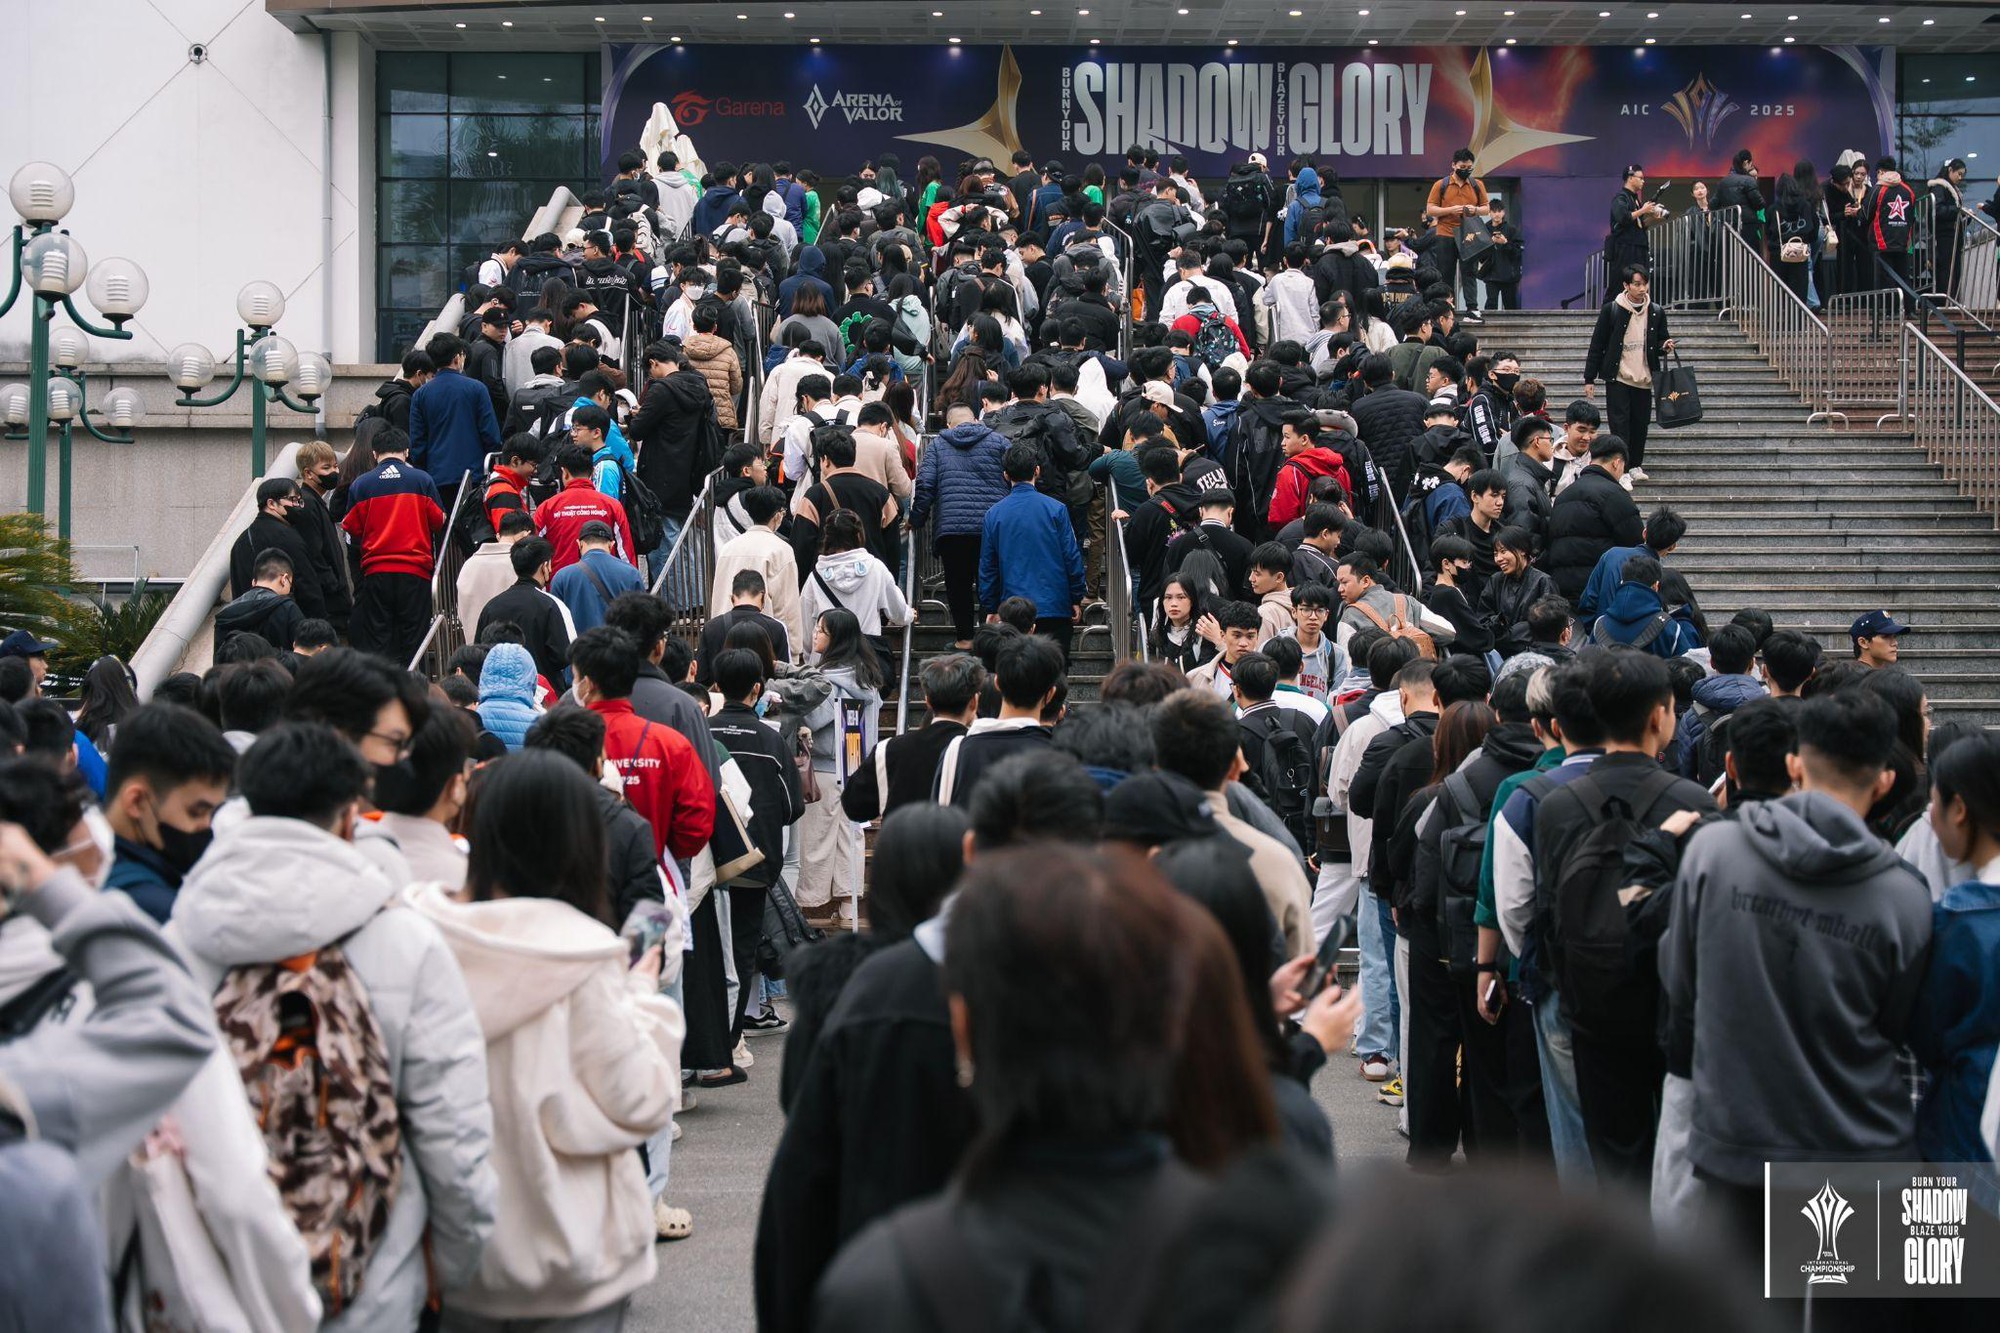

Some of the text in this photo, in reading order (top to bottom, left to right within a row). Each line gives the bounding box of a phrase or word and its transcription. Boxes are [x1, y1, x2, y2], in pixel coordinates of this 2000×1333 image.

[715, 97, 785, 117] Garena
[831, 89, 896, 107] ARENA
[842, 107, 904, 125] VALOR
[1073, 61, 1274, 156] SHADOW
[1288, 61, 1433, 156] GLORY
[1620, 104, 1650, 116] AIC
[1749, 104, 1796, 116] 2025
